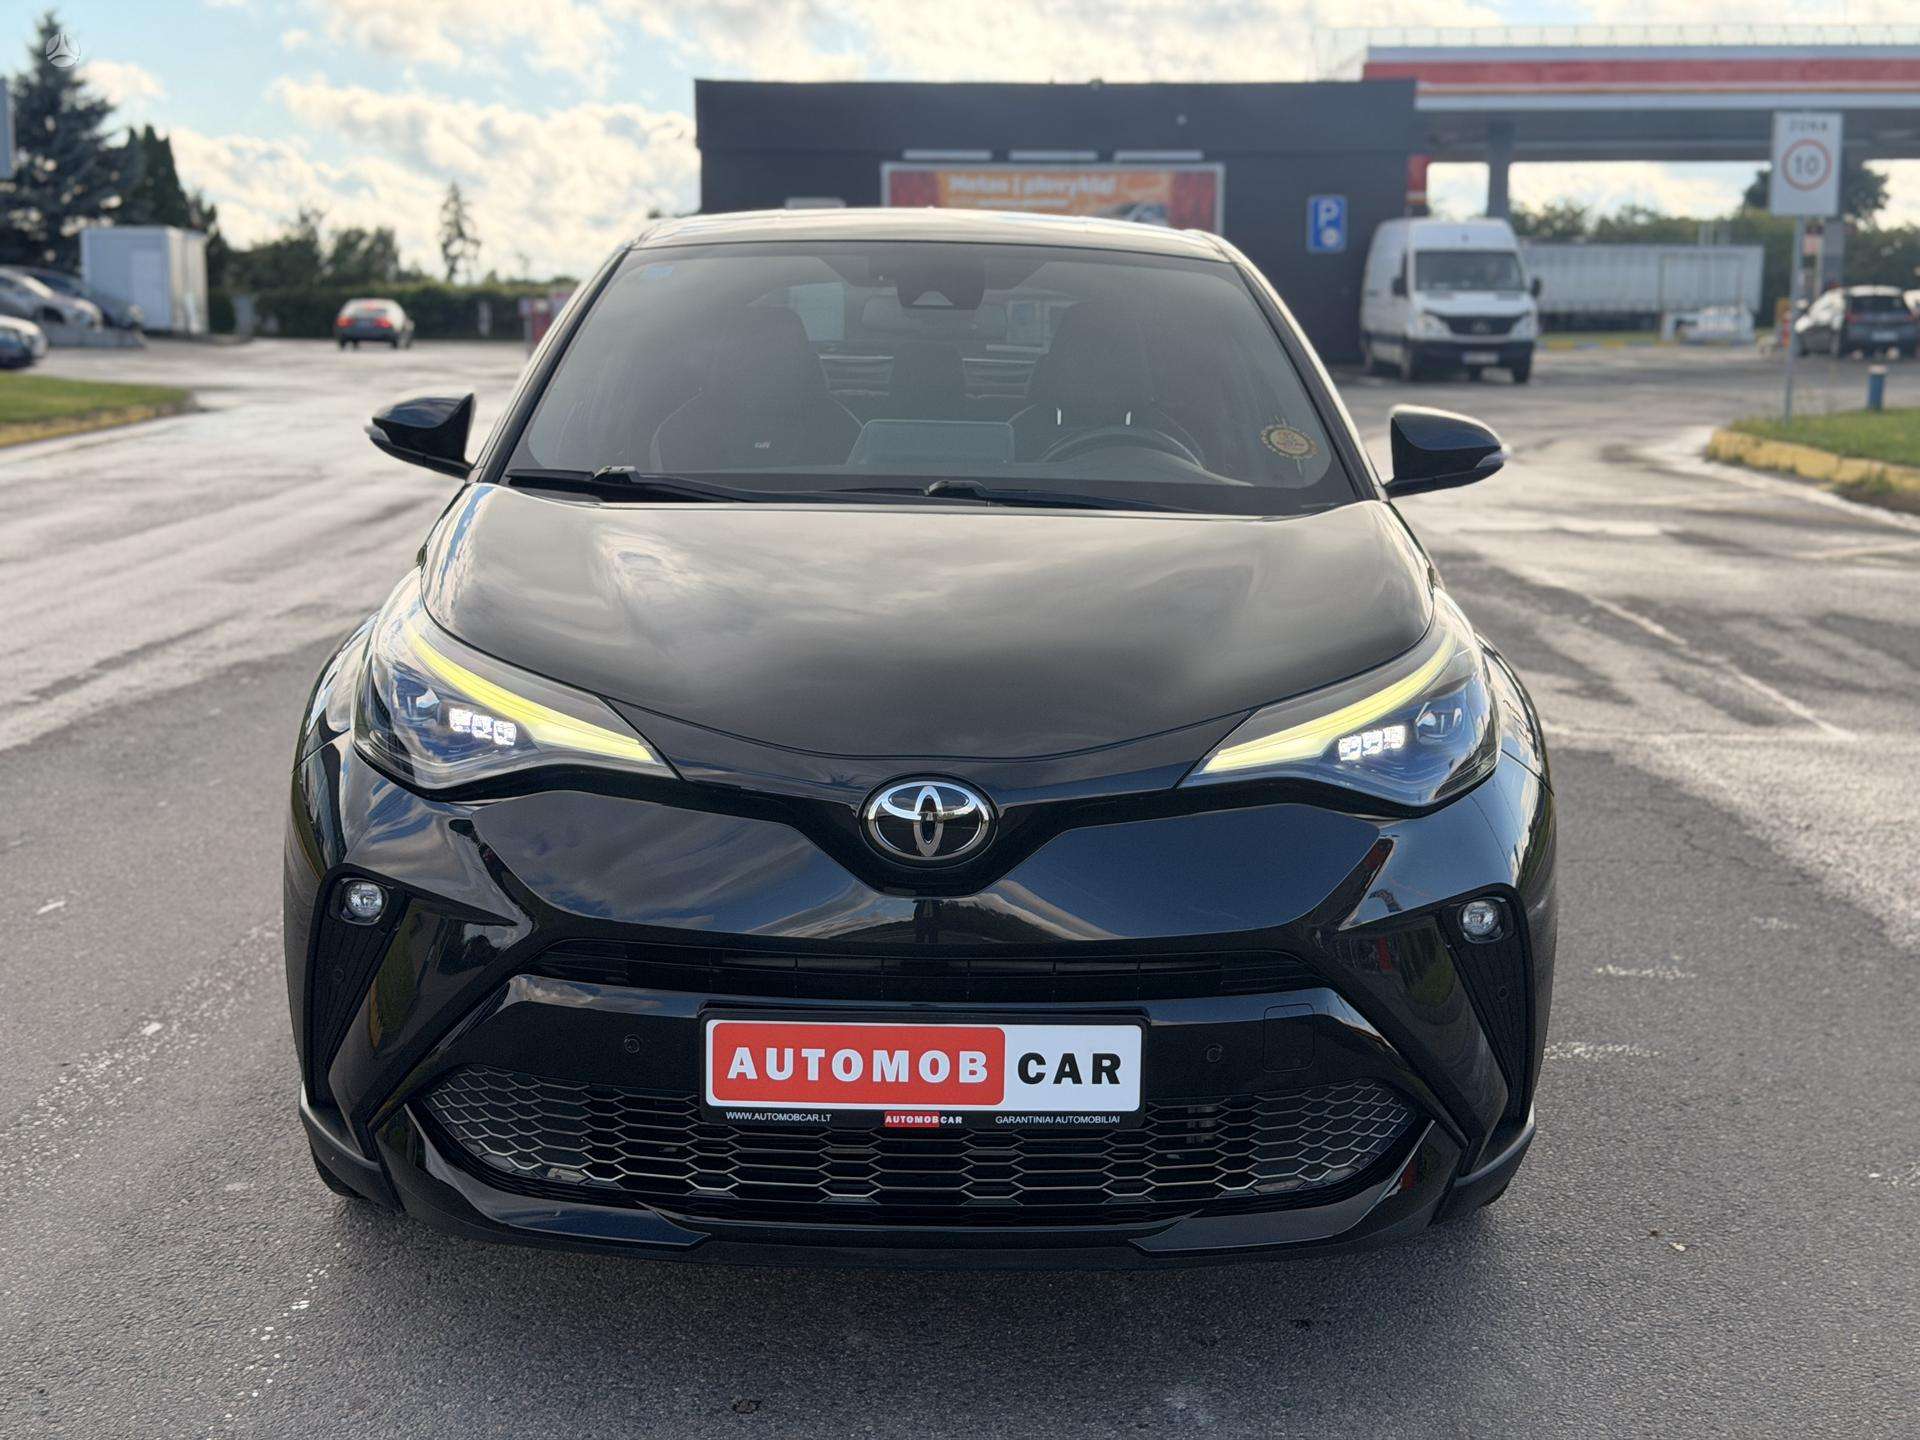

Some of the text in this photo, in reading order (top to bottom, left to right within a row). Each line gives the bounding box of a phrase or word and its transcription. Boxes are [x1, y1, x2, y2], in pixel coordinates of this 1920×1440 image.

[1795, 155, 1820, 175] 10
[1319, 199, 1338, 227] P
[727, 1047, 1121, 1085] AUTOMOB CAR
[726, 1111, 832, 1123] WWW.AUTOMOBCAR.LT
[995, 1115, 1120, 1125] GARANTINIAI AUTOMOBILIAI
